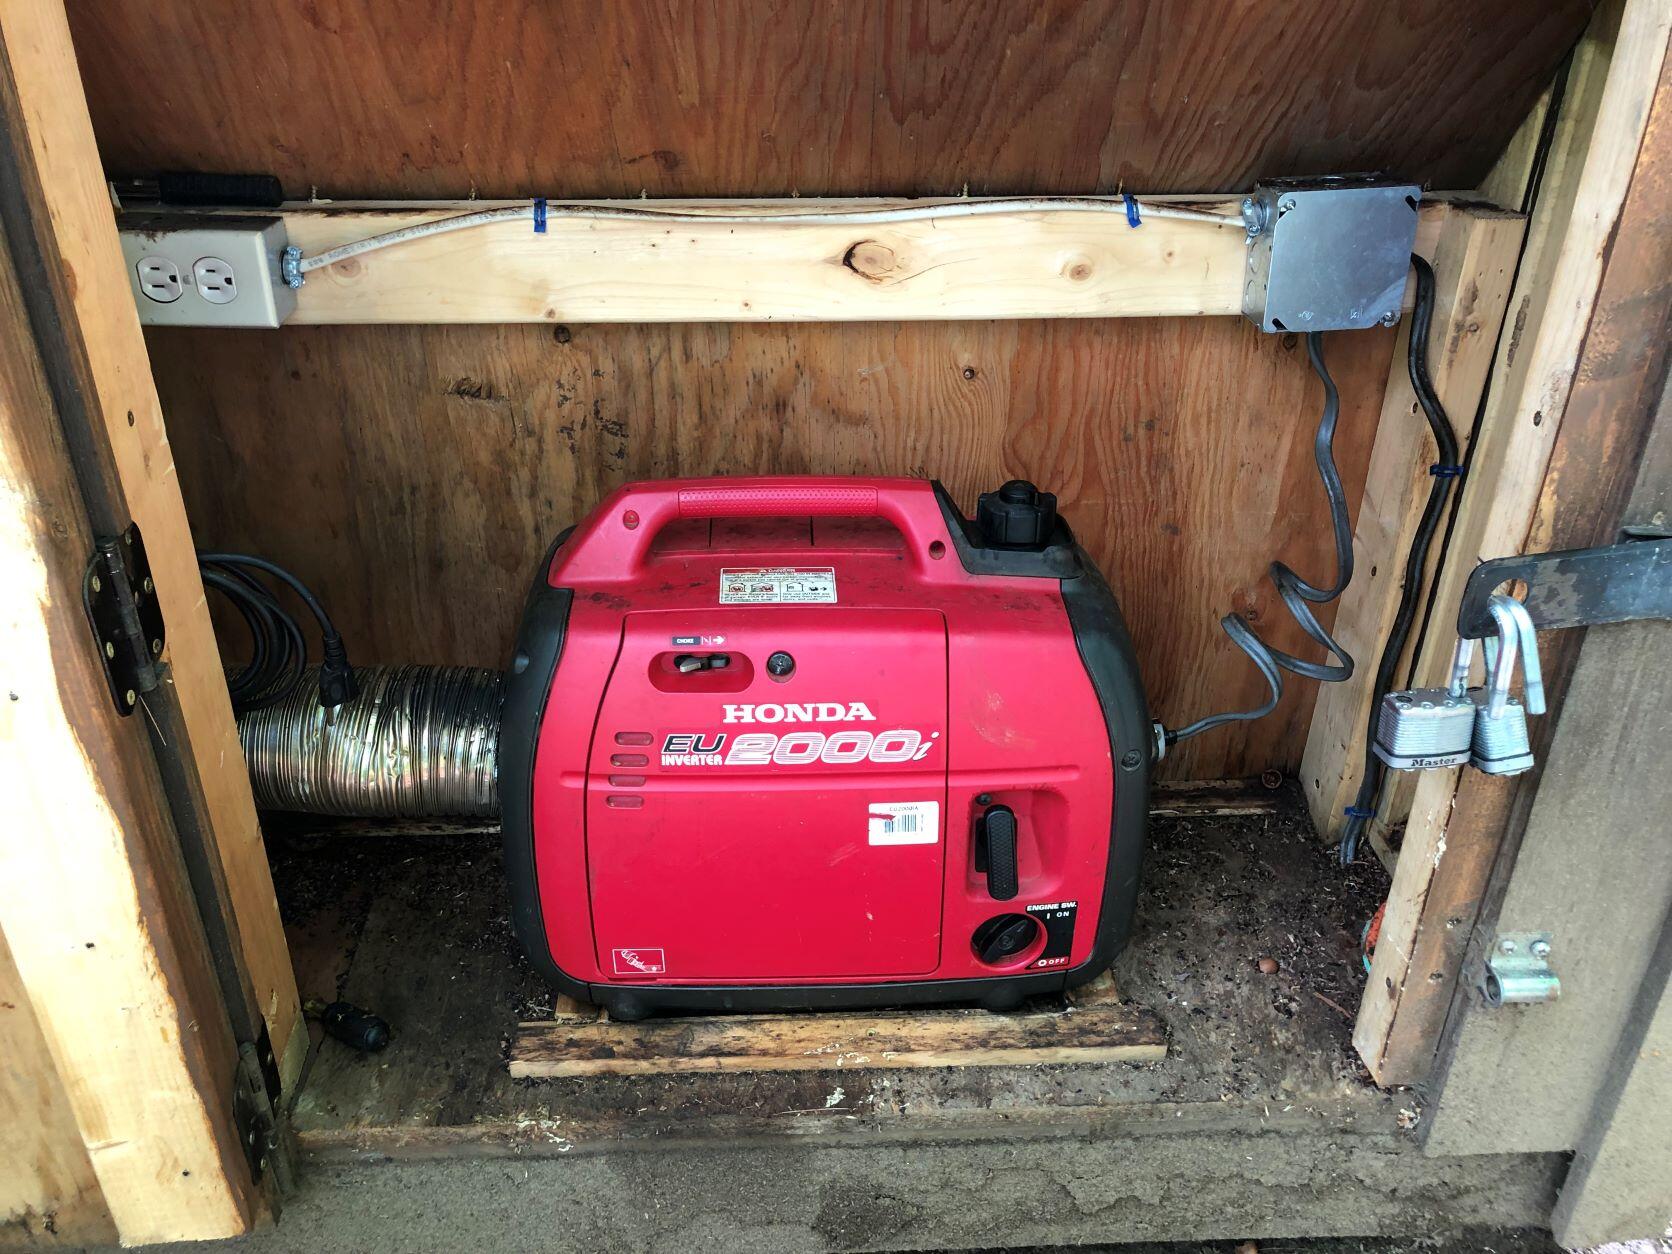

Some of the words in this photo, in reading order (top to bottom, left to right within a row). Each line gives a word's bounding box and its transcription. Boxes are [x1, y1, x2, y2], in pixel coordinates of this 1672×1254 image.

[722, 702, 876, 723] HONDA
[660, 733, 727, 754] EU
[724, 729, 940, 765] 2000i
[661, 754, 723, 766] INVERTER
[1410, 757, 1457, 767] Master
[1026, 903, 1059, 912] ENGINE
[1061, 901, 1077, 909] SW.
[1048, 957, 1065, 965] OFF
